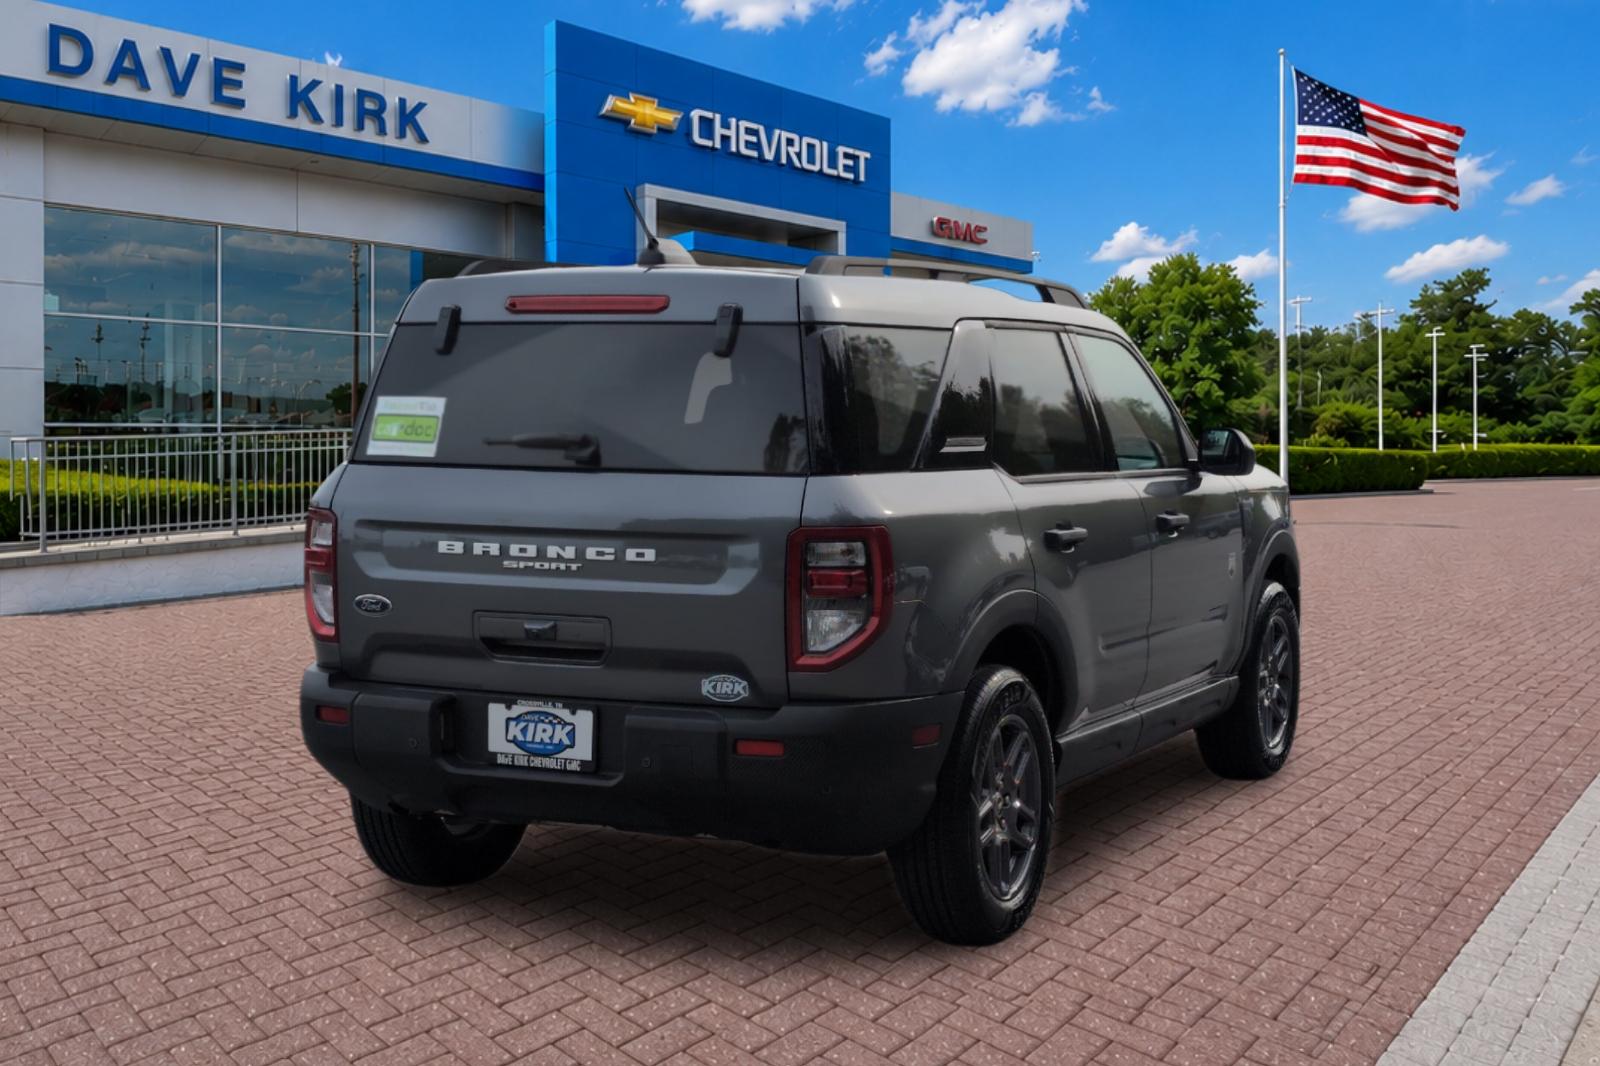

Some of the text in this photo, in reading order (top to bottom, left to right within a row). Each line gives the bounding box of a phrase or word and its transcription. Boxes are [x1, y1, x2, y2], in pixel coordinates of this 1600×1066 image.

[47, 23, 430, 143] DAVE KIRK
[690, 109, 871, 182] CHEVROLET
[931, 216, 988, 244] GMC
[437, 540, 656, 562] BRONCO
[502, 560, 582, 571] SPORT
[703, 681, 747, 696] KIRK
[506, 721, 574, 745] KIRK
[496, 753, 581, 771] DAVE KIRK CHEVROLET GMC
